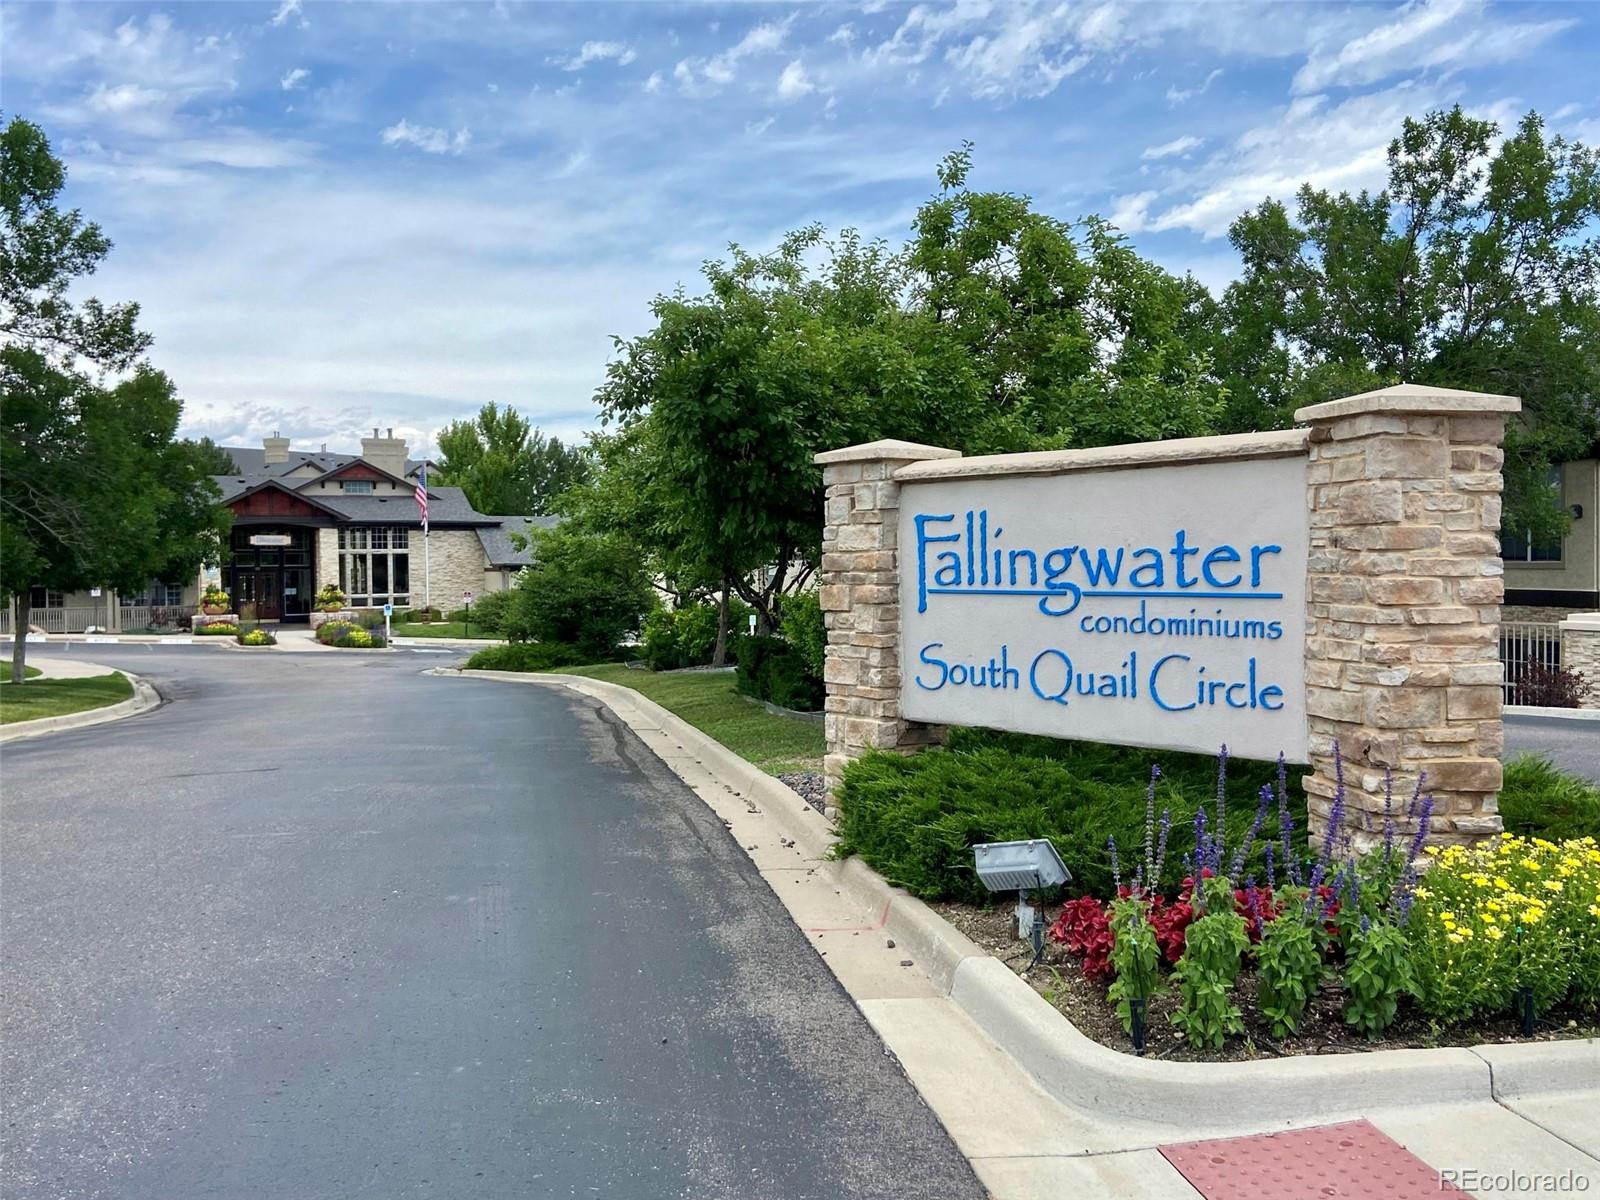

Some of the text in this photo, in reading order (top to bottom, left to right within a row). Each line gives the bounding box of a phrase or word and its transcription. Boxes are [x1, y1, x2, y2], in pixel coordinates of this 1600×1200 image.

[913, 510, 1282, 616] Fallingwater
[1080, 600, 1283, 639] condominiums
[916, 643, 1284, 711] South Quail Circle
